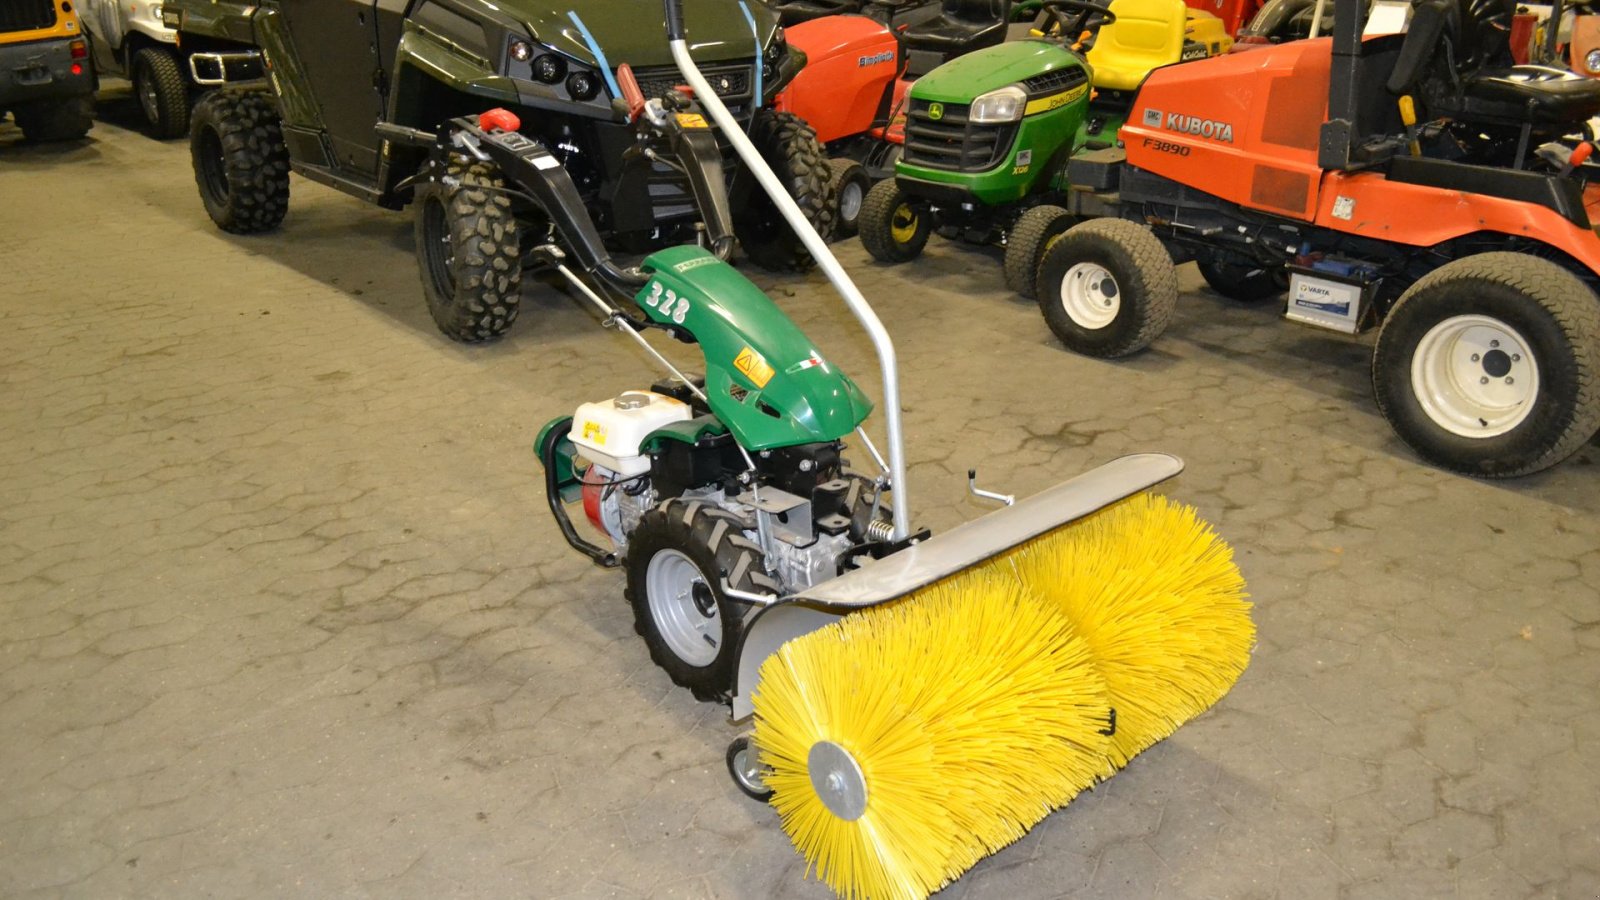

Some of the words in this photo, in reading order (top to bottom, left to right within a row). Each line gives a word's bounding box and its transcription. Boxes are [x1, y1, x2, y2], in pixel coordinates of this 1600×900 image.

[1166, 112, 1233, 144] KUBOTA
[1143, 137, 1190, 157] F3890
[645, 280, 690, 324] 328
[1308, 286, 1330, 296] VARTA
